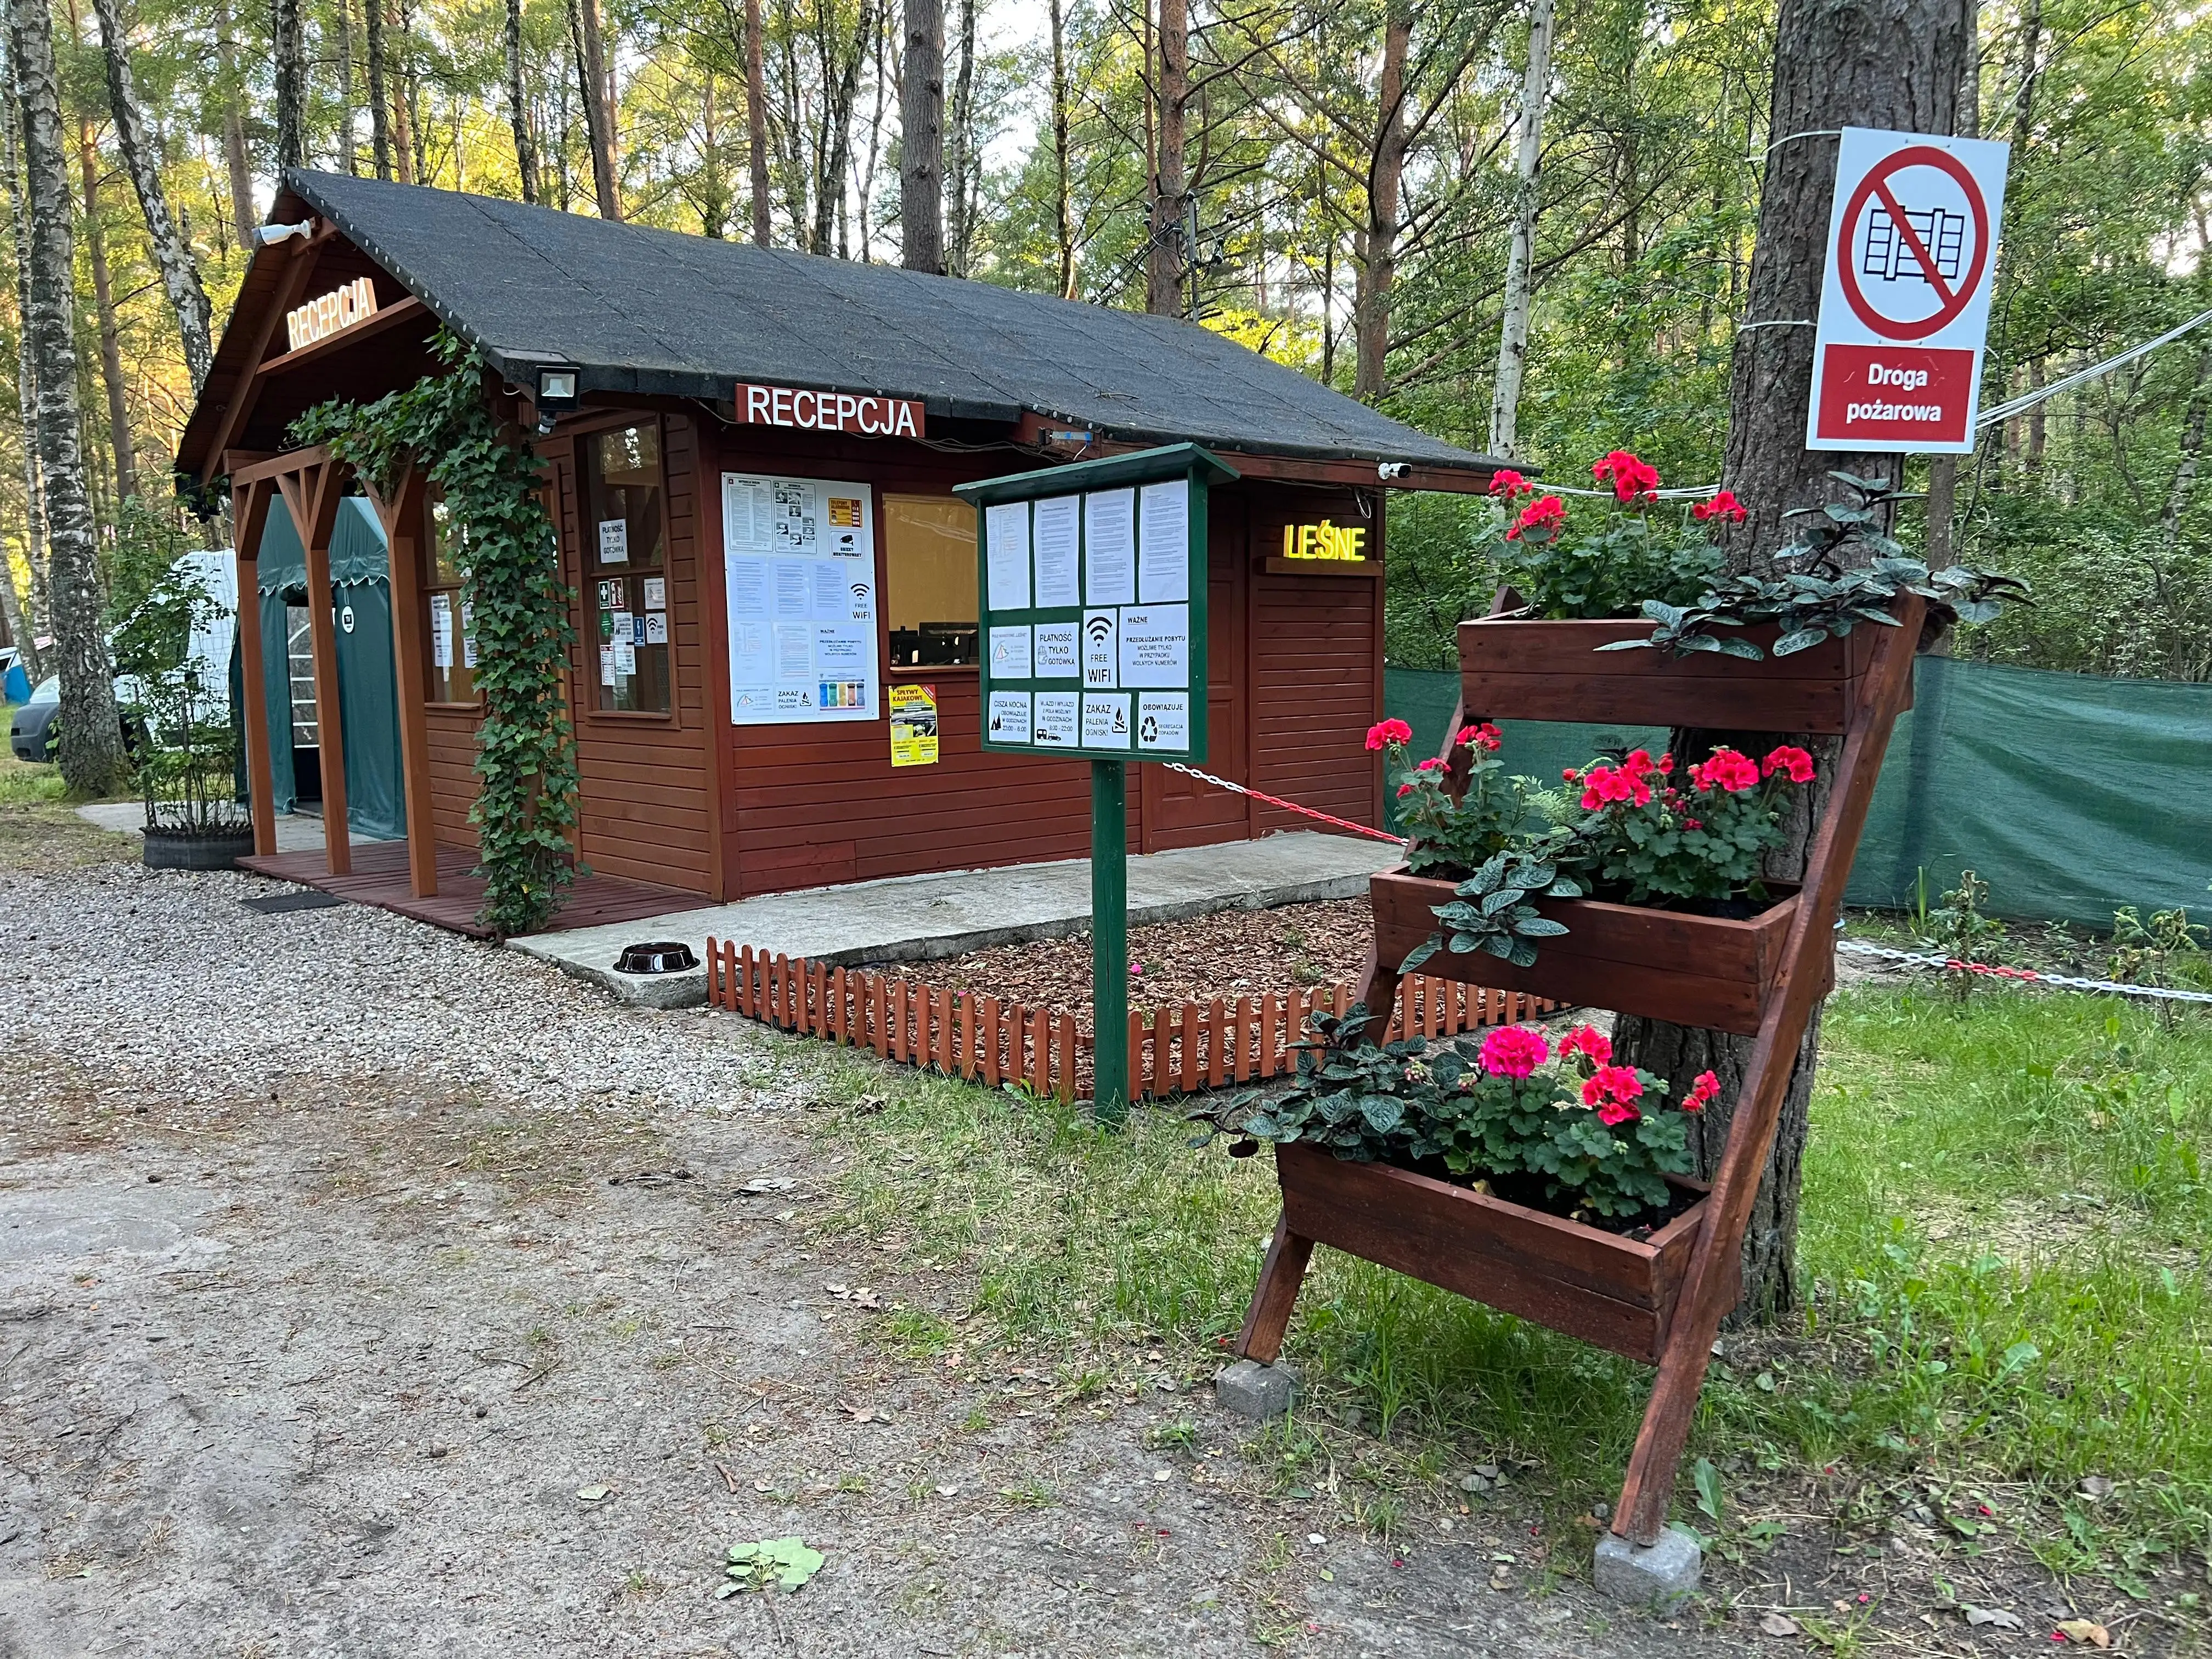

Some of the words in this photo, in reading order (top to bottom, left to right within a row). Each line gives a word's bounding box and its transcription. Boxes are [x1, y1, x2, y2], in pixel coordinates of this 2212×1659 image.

[286, 276, 376, 352] RECEPCJA
[1867, 363, 1928, 392] Droga
[747, 386, 917, 437] RECEPCJA
[1846, 398, 1942, 424] pożarowa
[1284, 519, 1365, 561] LEŚNE
[853, 611, 870, 619] WIFI
[1040, 631, 1072, 642] PŁATNOŚĆ
[1048, 657, 1075, 667] GOTÓWKĄ
[1091, 654, 1108, 662] FREE
[1088, 669, 1110, 682] WIFI
[1086, 704, 1111, 714] ZAKAZ
